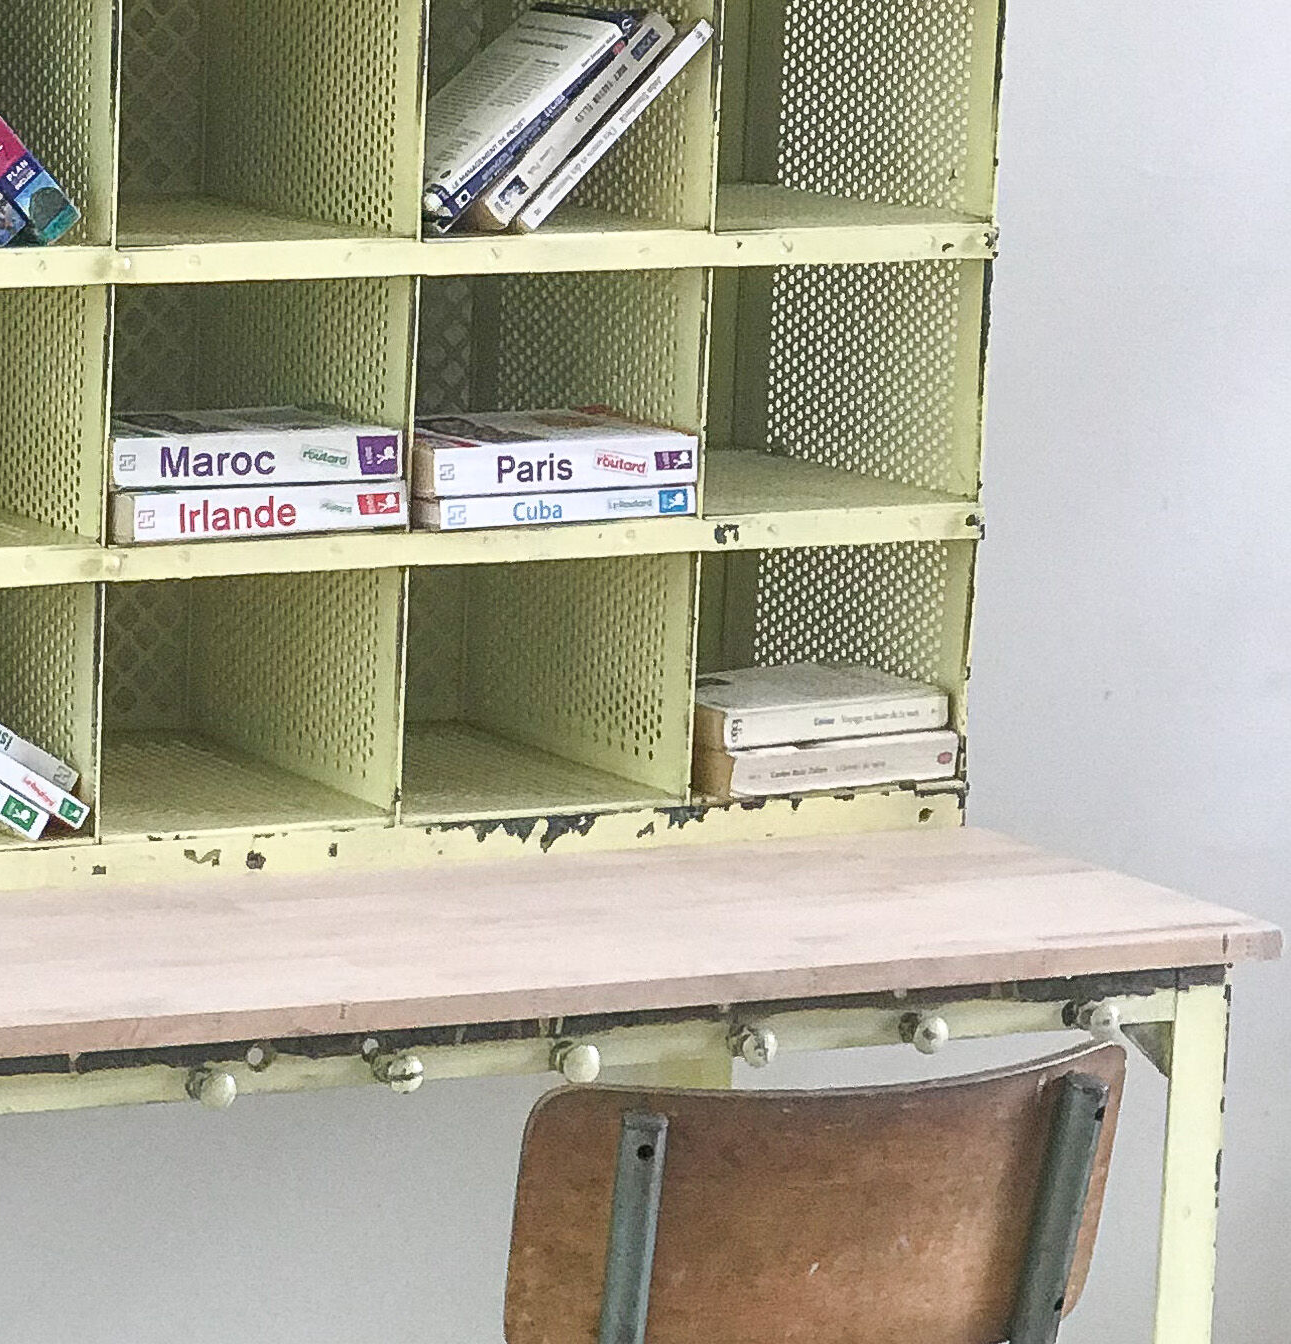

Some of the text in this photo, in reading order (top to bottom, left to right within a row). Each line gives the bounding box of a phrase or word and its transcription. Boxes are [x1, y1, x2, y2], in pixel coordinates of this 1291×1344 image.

[160, 445, 276, 478] Maroc
[497, 452, 573, 484] Paris
[597, 456, 646, 474] routard
[179, 496, 297, 534] Irlande
[513, 500, 563, 522] Cuba
